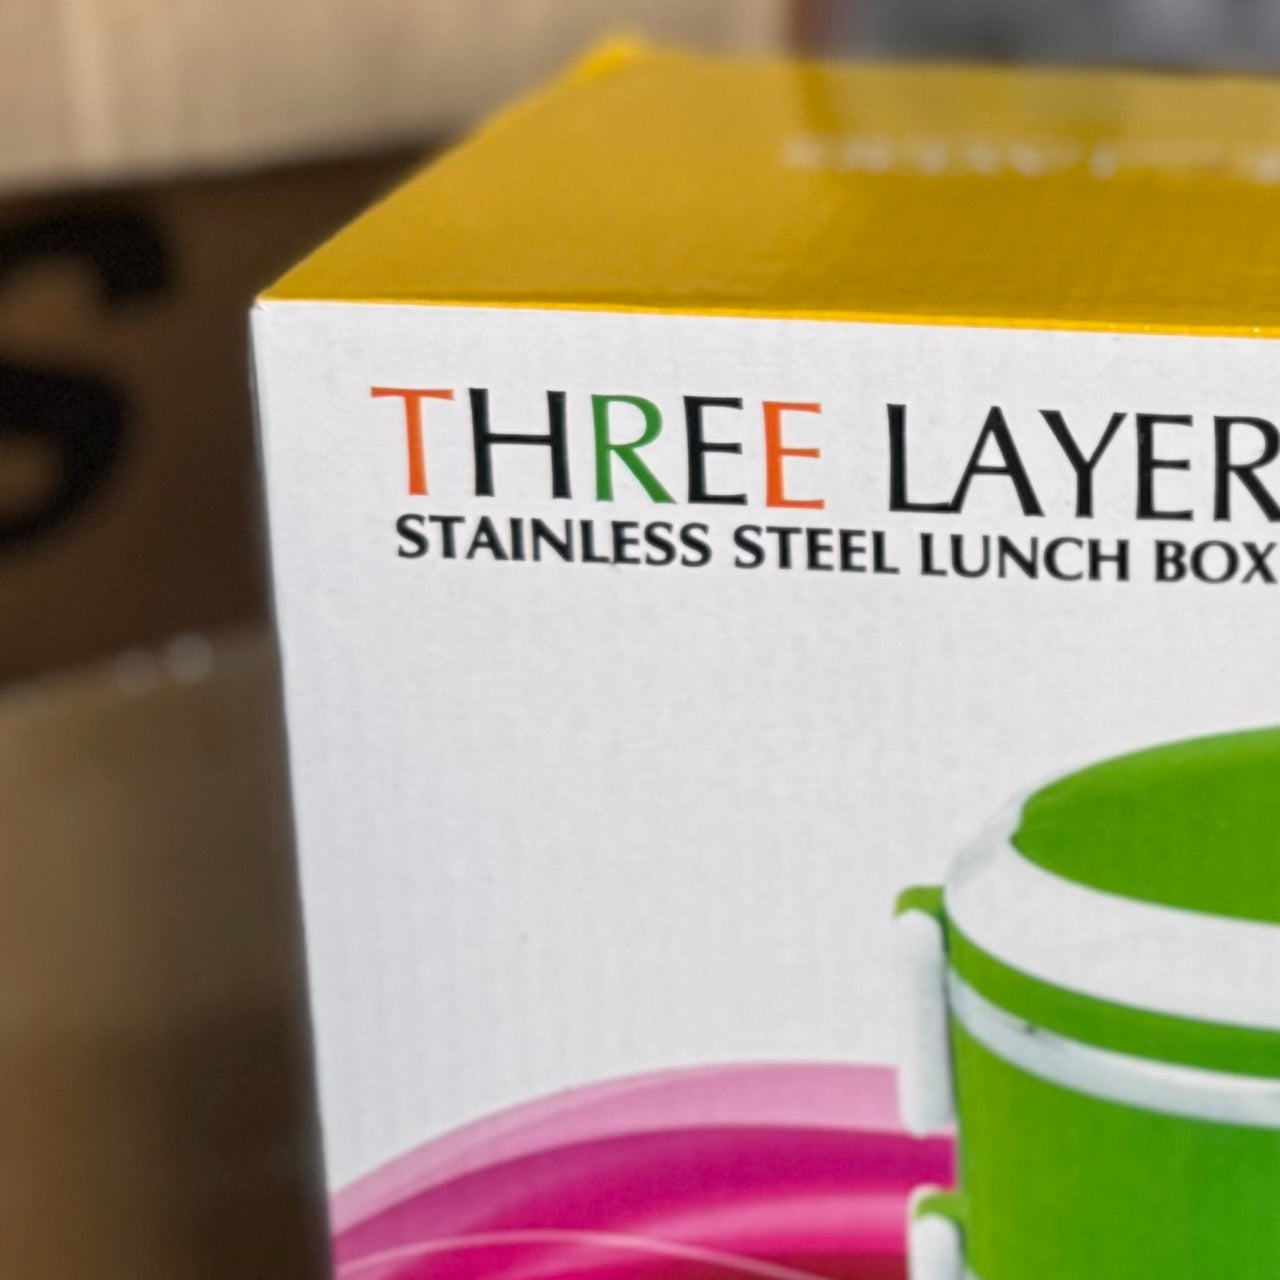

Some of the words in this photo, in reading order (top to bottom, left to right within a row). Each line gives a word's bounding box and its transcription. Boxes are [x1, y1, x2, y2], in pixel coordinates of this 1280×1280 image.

[370, 386, 825, 510] THREE
[395, 513, 713, 568] STAINLESS
[733, 524, 901, 575] STEEL
[919, 532, 1130, 582] LUNCH
[1154, 539, 1279, 585] BOX
